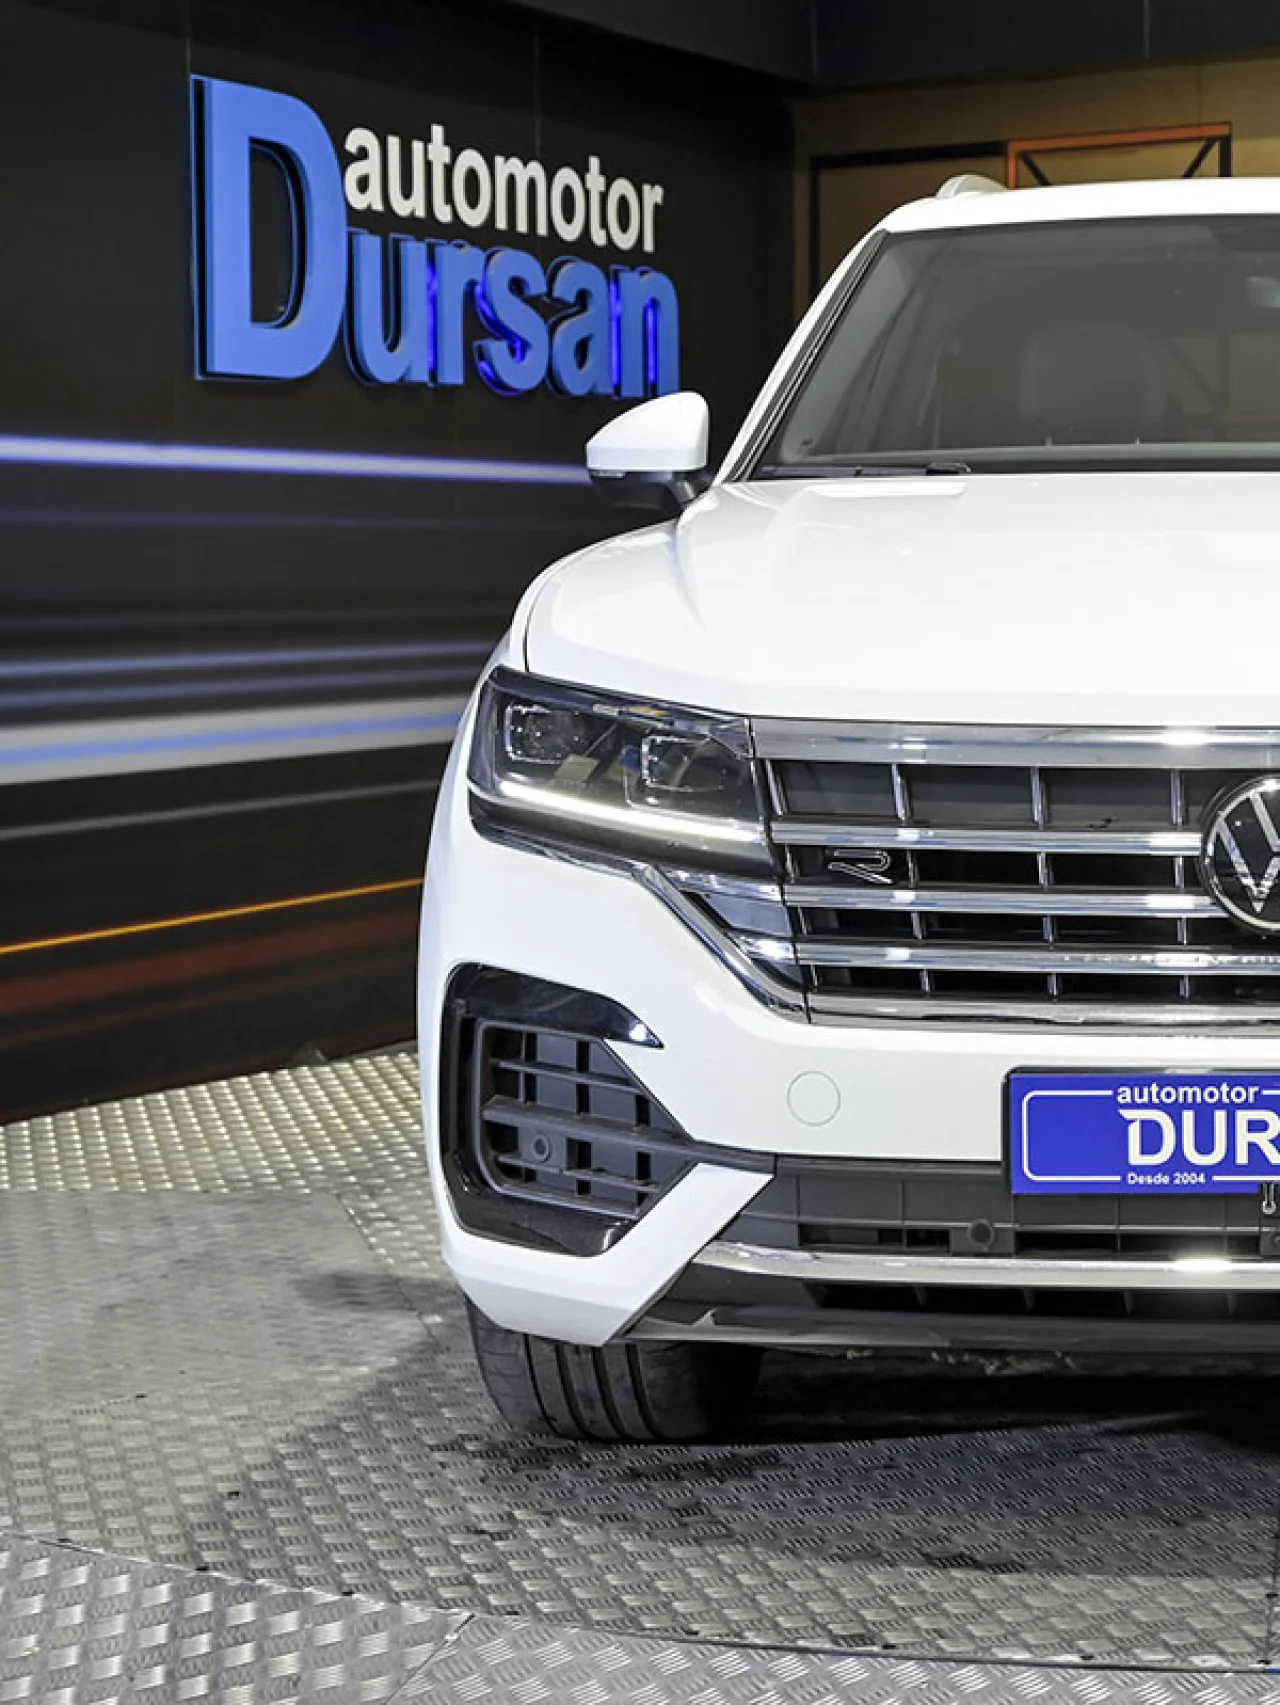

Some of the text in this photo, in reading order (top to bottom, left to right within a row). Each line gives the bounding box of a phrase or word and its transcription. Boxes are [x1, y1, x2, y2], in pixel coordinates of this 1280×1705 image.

[344, 123, 665, 253] automotor
[191, 74, 681, 399] Dursan
[1117, 1082, 1260, 1104] automotor
[1127, 1172, 1206, 1185] Desde 2004
